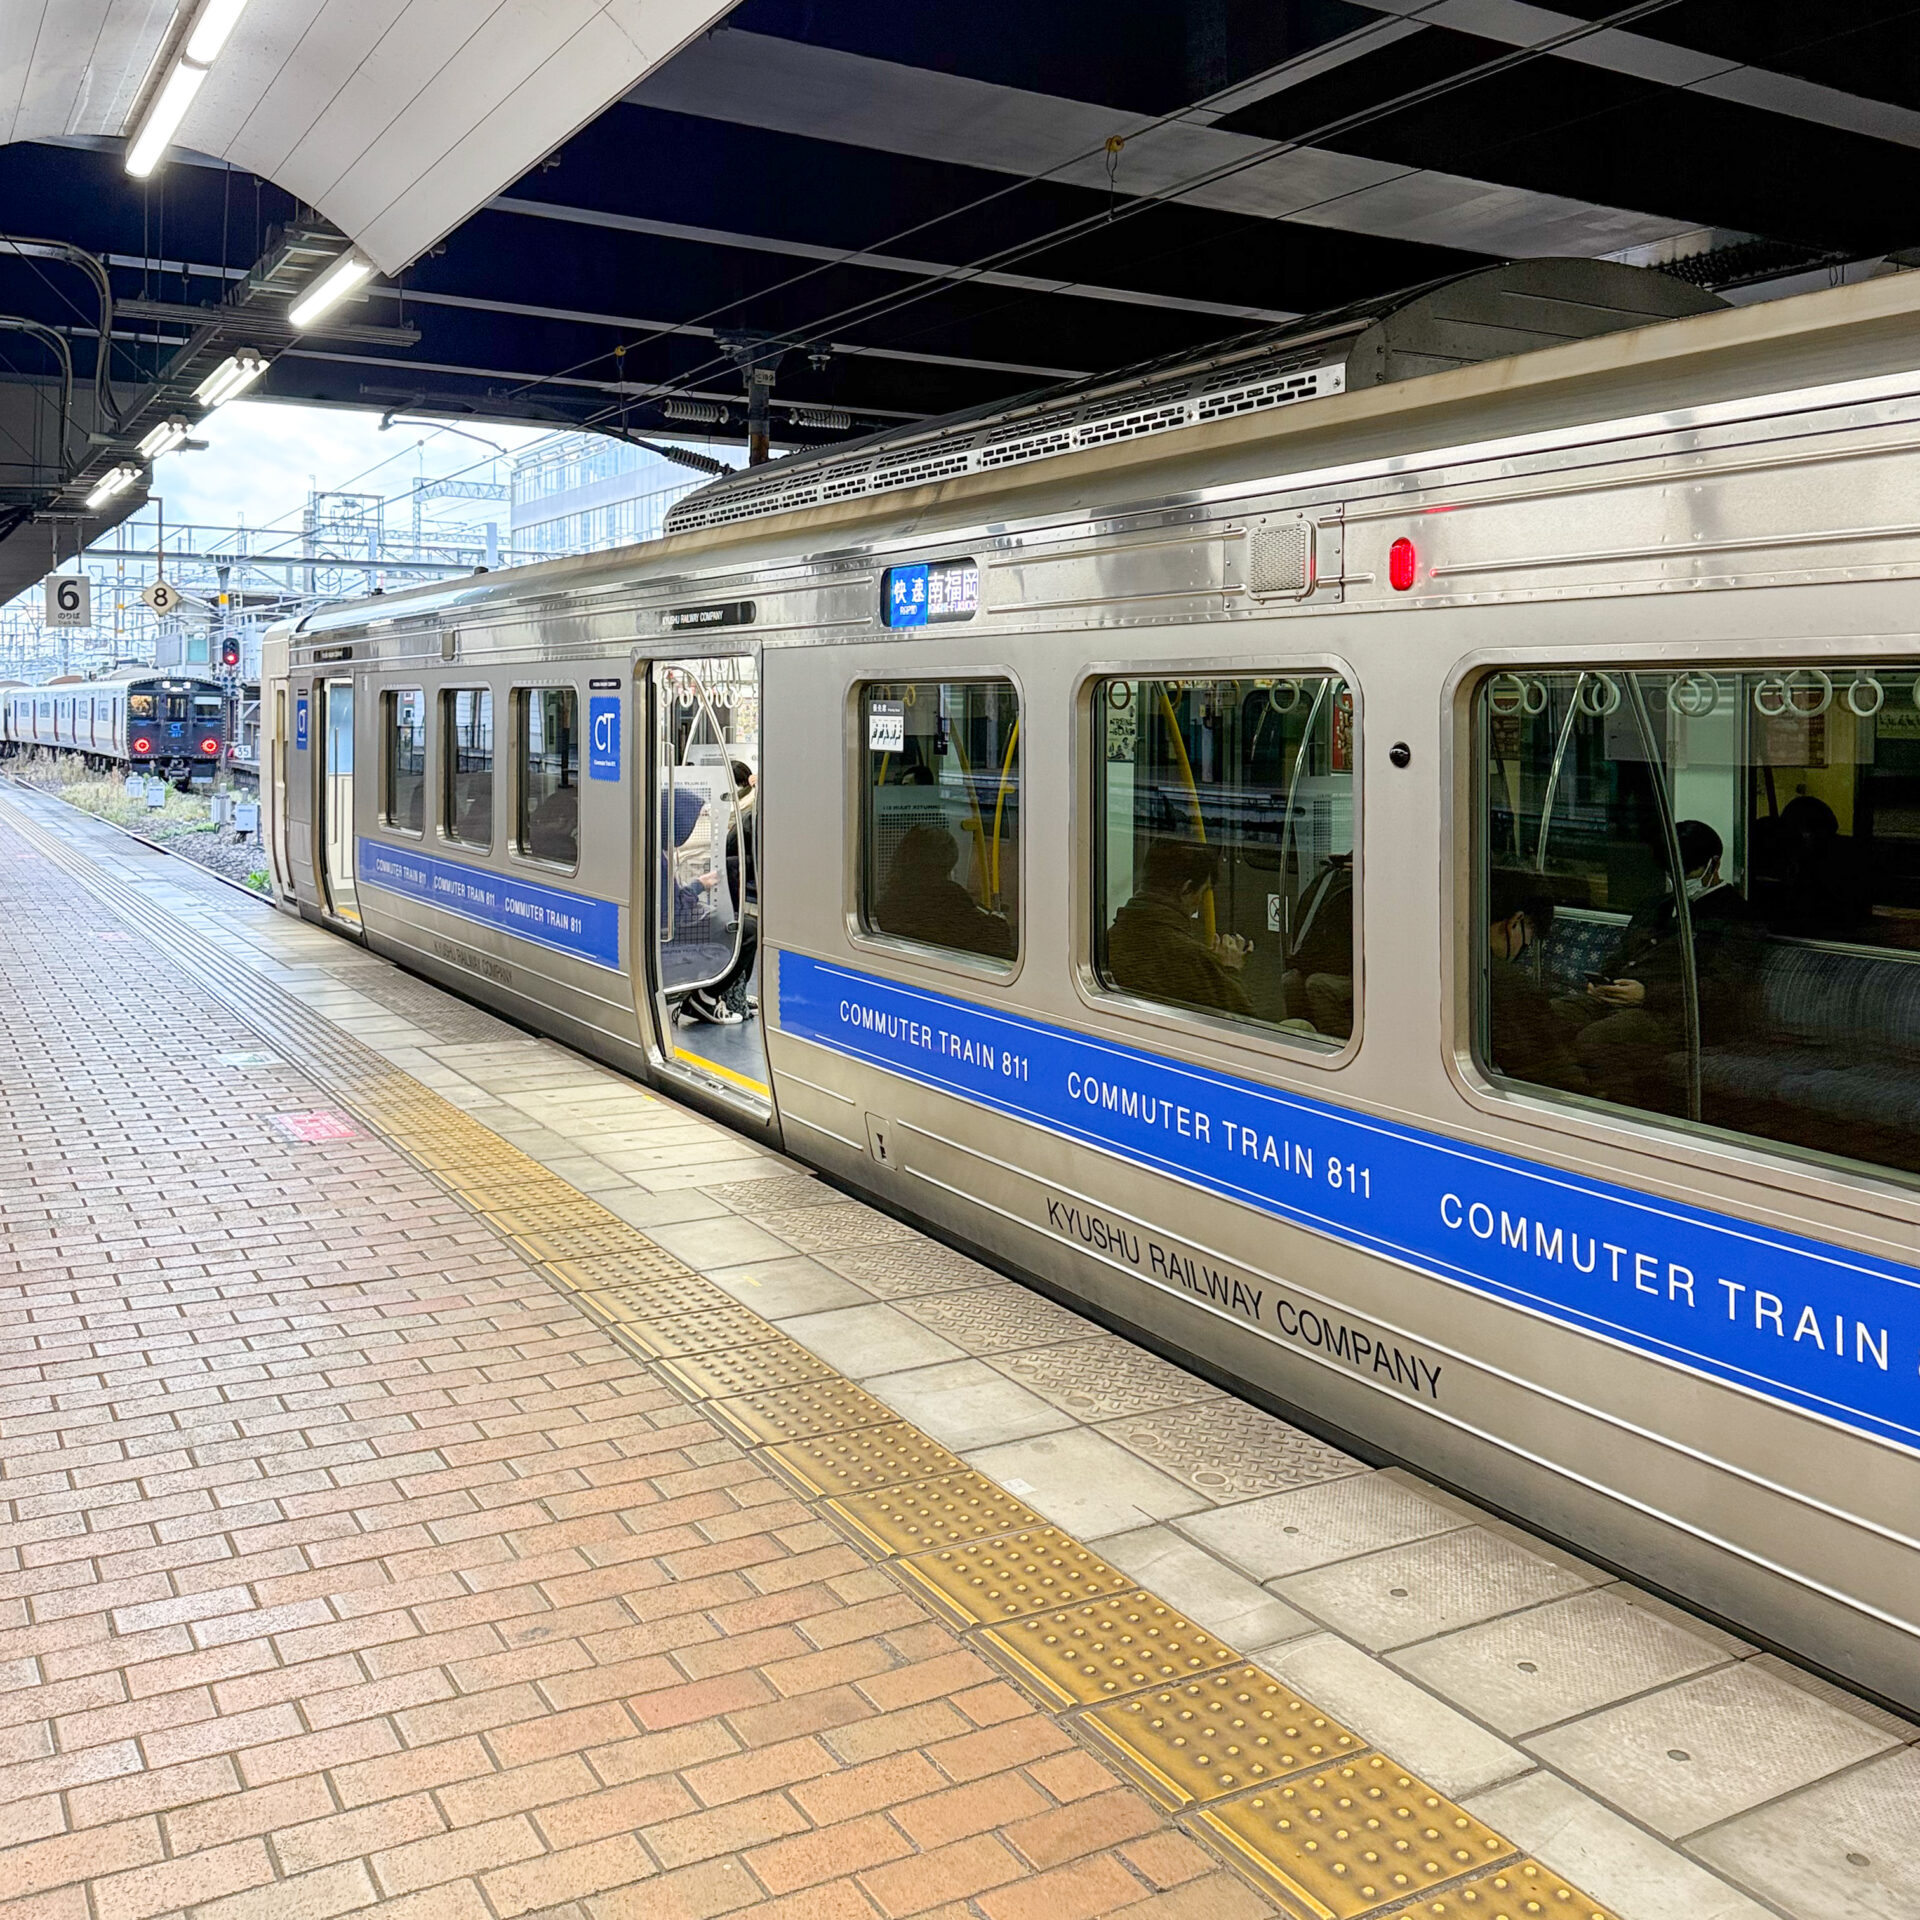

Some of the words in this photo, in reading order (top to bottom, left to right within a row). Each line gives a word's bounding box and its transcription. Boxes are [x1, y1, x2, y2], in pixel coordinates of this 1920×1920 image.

[57, 580, 80, 611] 6
[153, 587, 168, 607] 8
[893, 577, 925, 605] 快速
[927, 569, 979, 605] 南福岡
[237, 746, 250, 756] 35
[594, 712, 616, 754] CT
[375, 858, 402, 877] COMMUTER
[403, 866, 419, 884] TRAIN
[434, 875, 466, 897] COMMUTER
[467, 885, 485, 905] TRAIN
[486, 891, 496, 907] 811
[504, 897, 545, 922] COMMUTER
[546, 909, 569, 930] TRAIN
[570, 916, 582, 934] 811
[839, 1000, 932, 1050] COMMUTER
[938, 1030, 995, 1071] TRAIN
[1002, 1051, 1029, 1082] 811
[1067, 1071, 1211, 1143] COMMUTER
[1222, 1120, 1313, 1179] TRAIN
[1327, 1157, 1370, 1198] 811
[1046, 1197, 1140, 1264] KYUSHU
[1149, 1243, 1263, 1320] RAILWAY
[1276, 1300, 1442, 1399] COMPANY
[1440, 1193, 1696, 1308] COMMUTER
[1717, 1278, 1889, 1372] TRAIN
